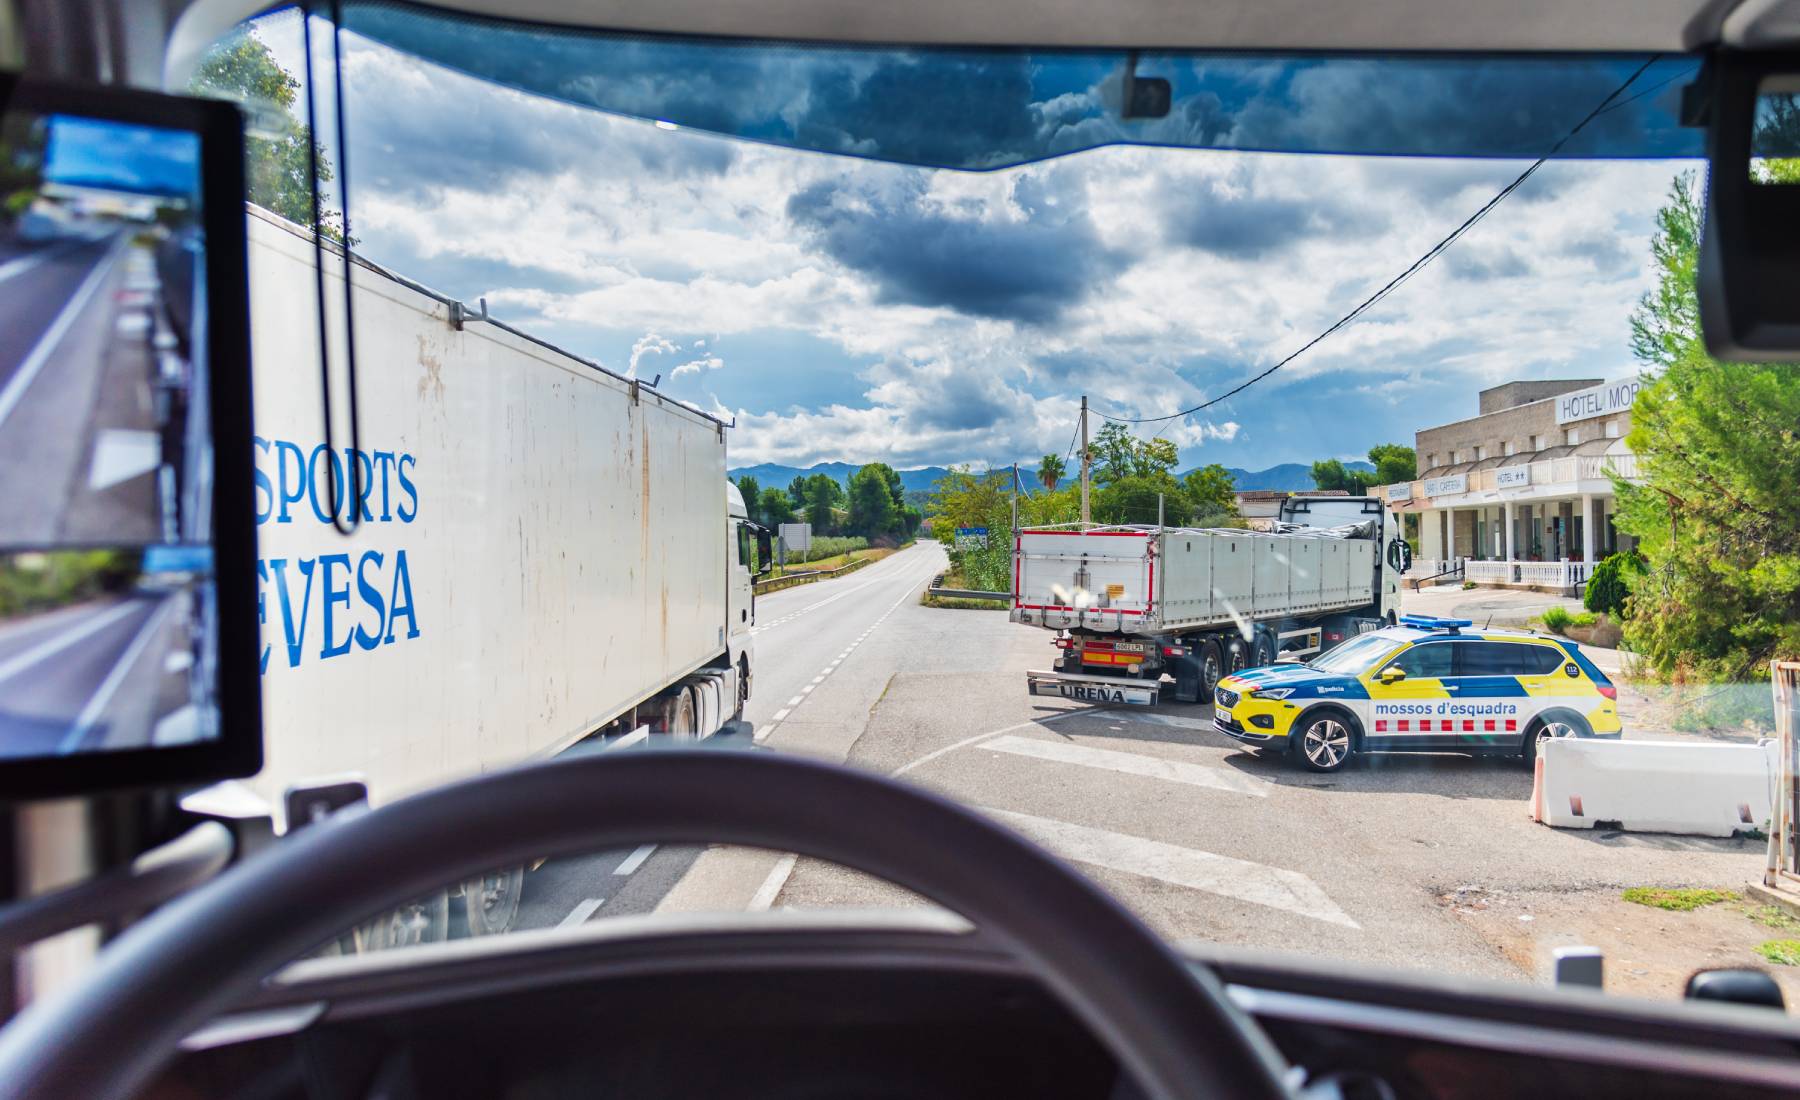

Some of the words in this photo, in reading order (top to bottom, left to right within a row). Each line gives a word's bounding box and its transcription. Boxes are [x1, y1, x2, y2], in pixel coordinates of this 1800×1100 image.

[1562, 393, 1602, 419] HOTEL
[1375, 704, 1433, 715] mossos
[1437, 702, 1517, 717] d'esquadra
